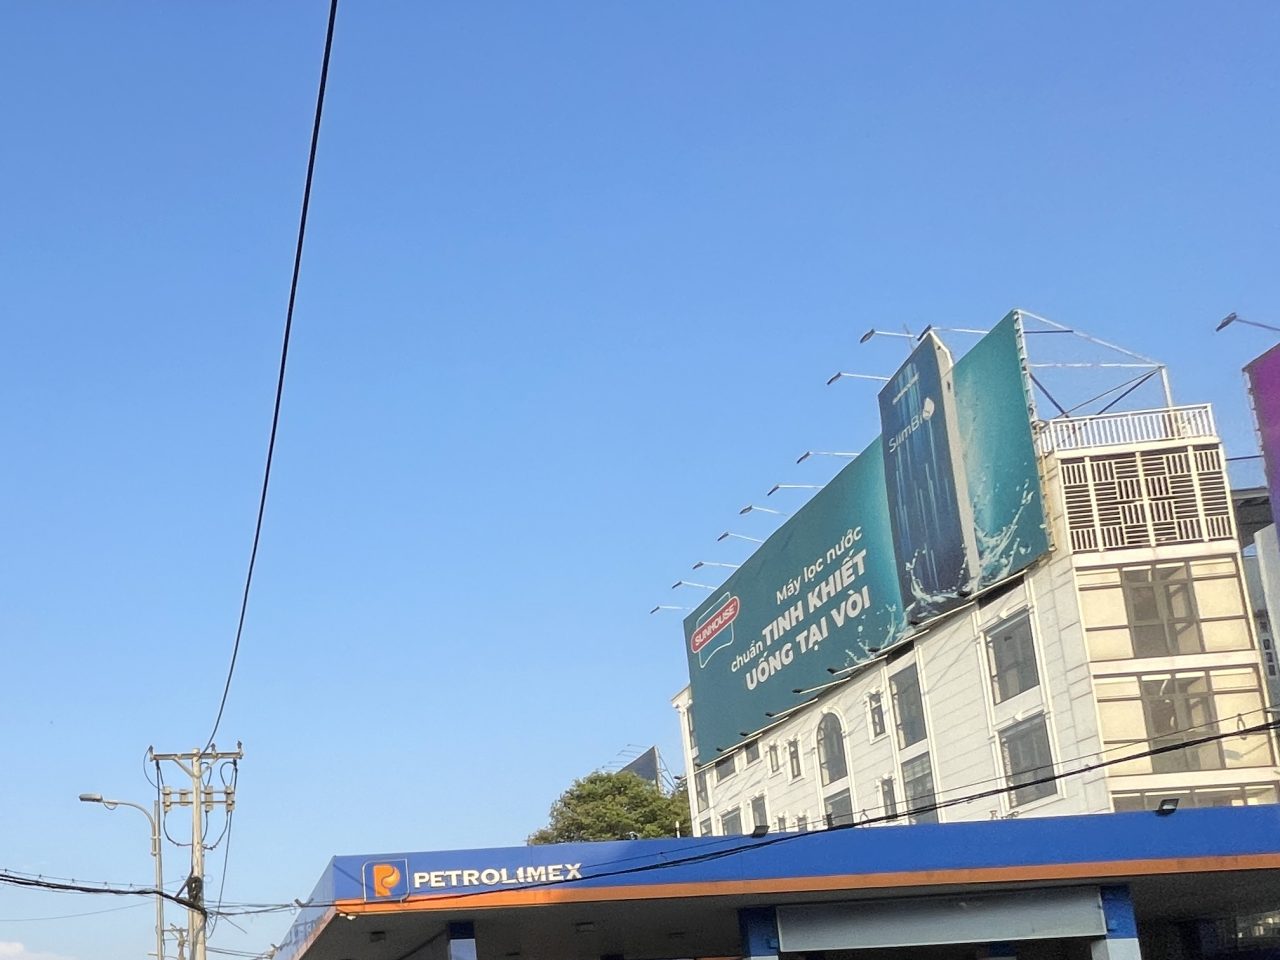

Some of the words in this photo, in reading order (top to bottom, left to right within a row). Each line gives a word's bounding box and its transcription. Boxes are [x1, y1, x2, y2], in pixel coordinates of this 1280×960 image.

[776, 574, 802, 605] Máy
[803, 558, 824, 583] lọc
[826, 526, 863, 564] nước
[694, 603, 737, 647] SUNHOUSE
[730, 640, 763, 673] chuẩn
[762, 600, 805, 646] TINH
[807, 549, 867, 614] KHIẾT
[745, 642, 794, 691] UỐNG
[795, 616, 829, 654] TẠI
[830, 585, 871, 628] VÒI
[413, 862, 583, 889] PETROLIMEX
